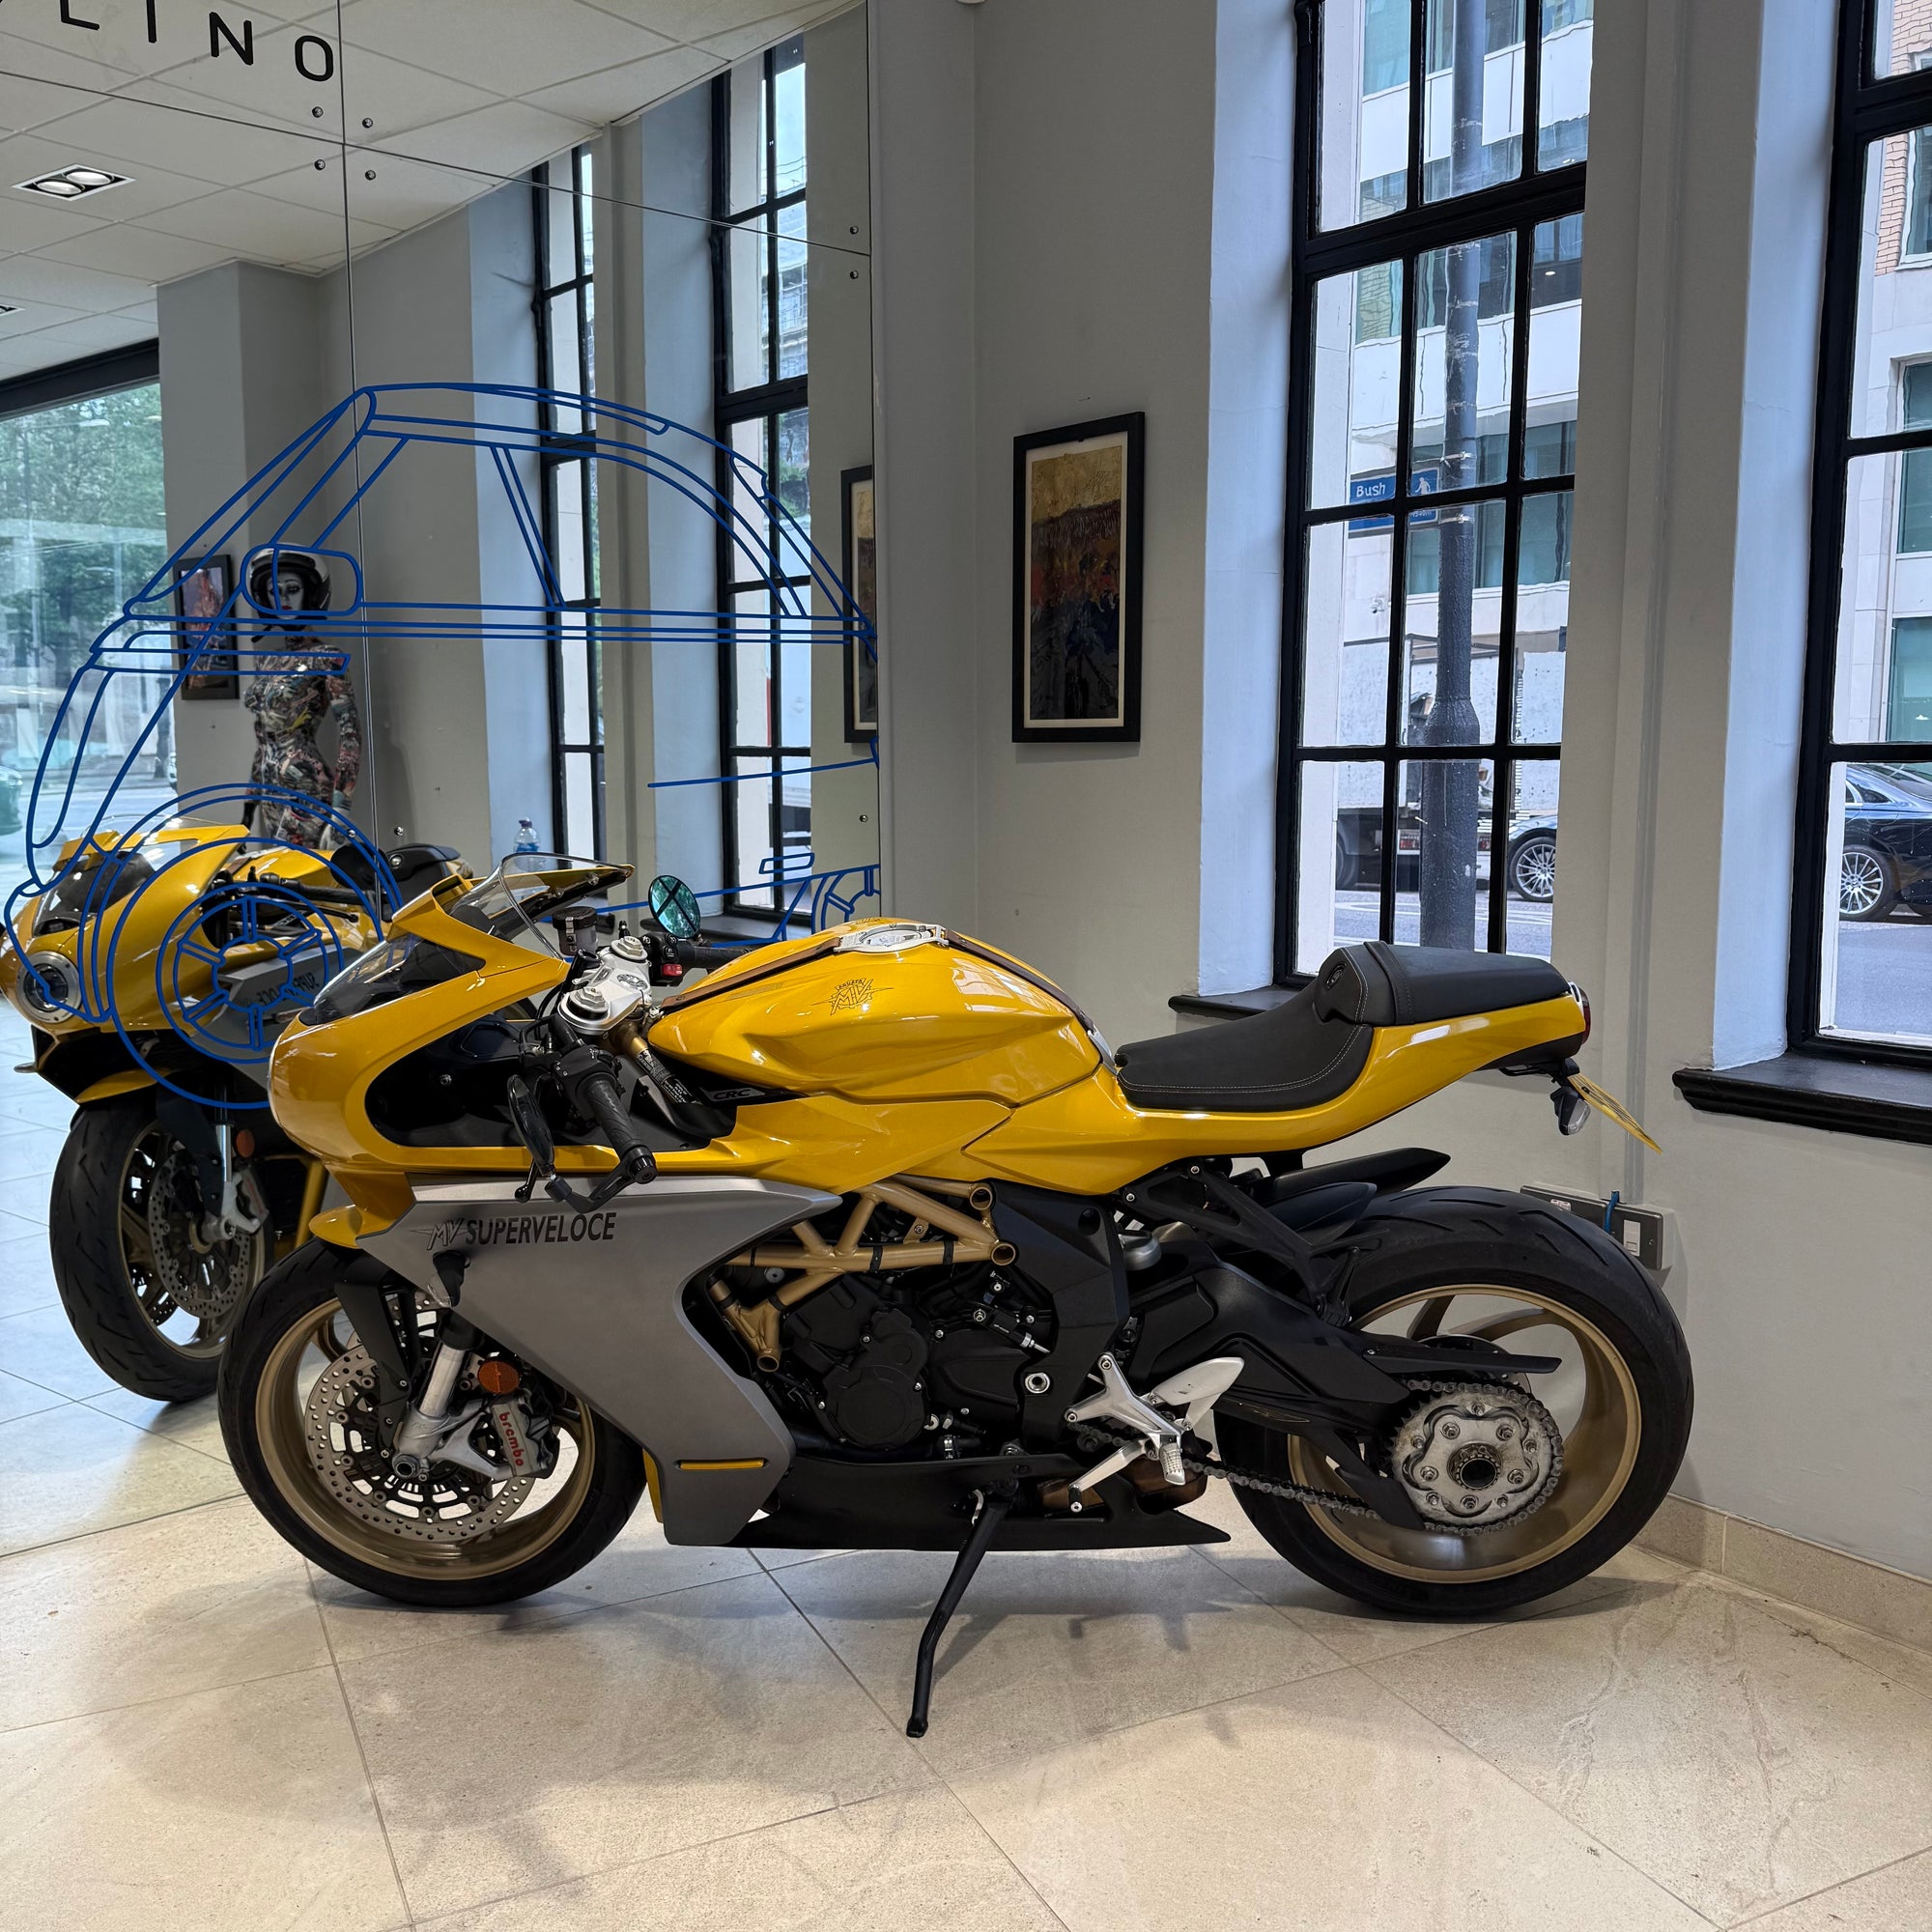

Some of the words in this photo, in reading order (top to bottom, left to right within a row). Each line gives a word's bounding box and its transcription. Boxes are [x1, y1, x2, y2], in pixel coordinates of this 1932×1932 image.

[1355, 482, 1386, 497] Bush
[831, 979, 874, 1015] MV
[714, 1089, 752, 1100] CRC
[426, 1218, 465, 1250] MV
[466, 1212, 617, 1245] SUPERVELOCE
[498, 1411, 525, 1466] brembo
